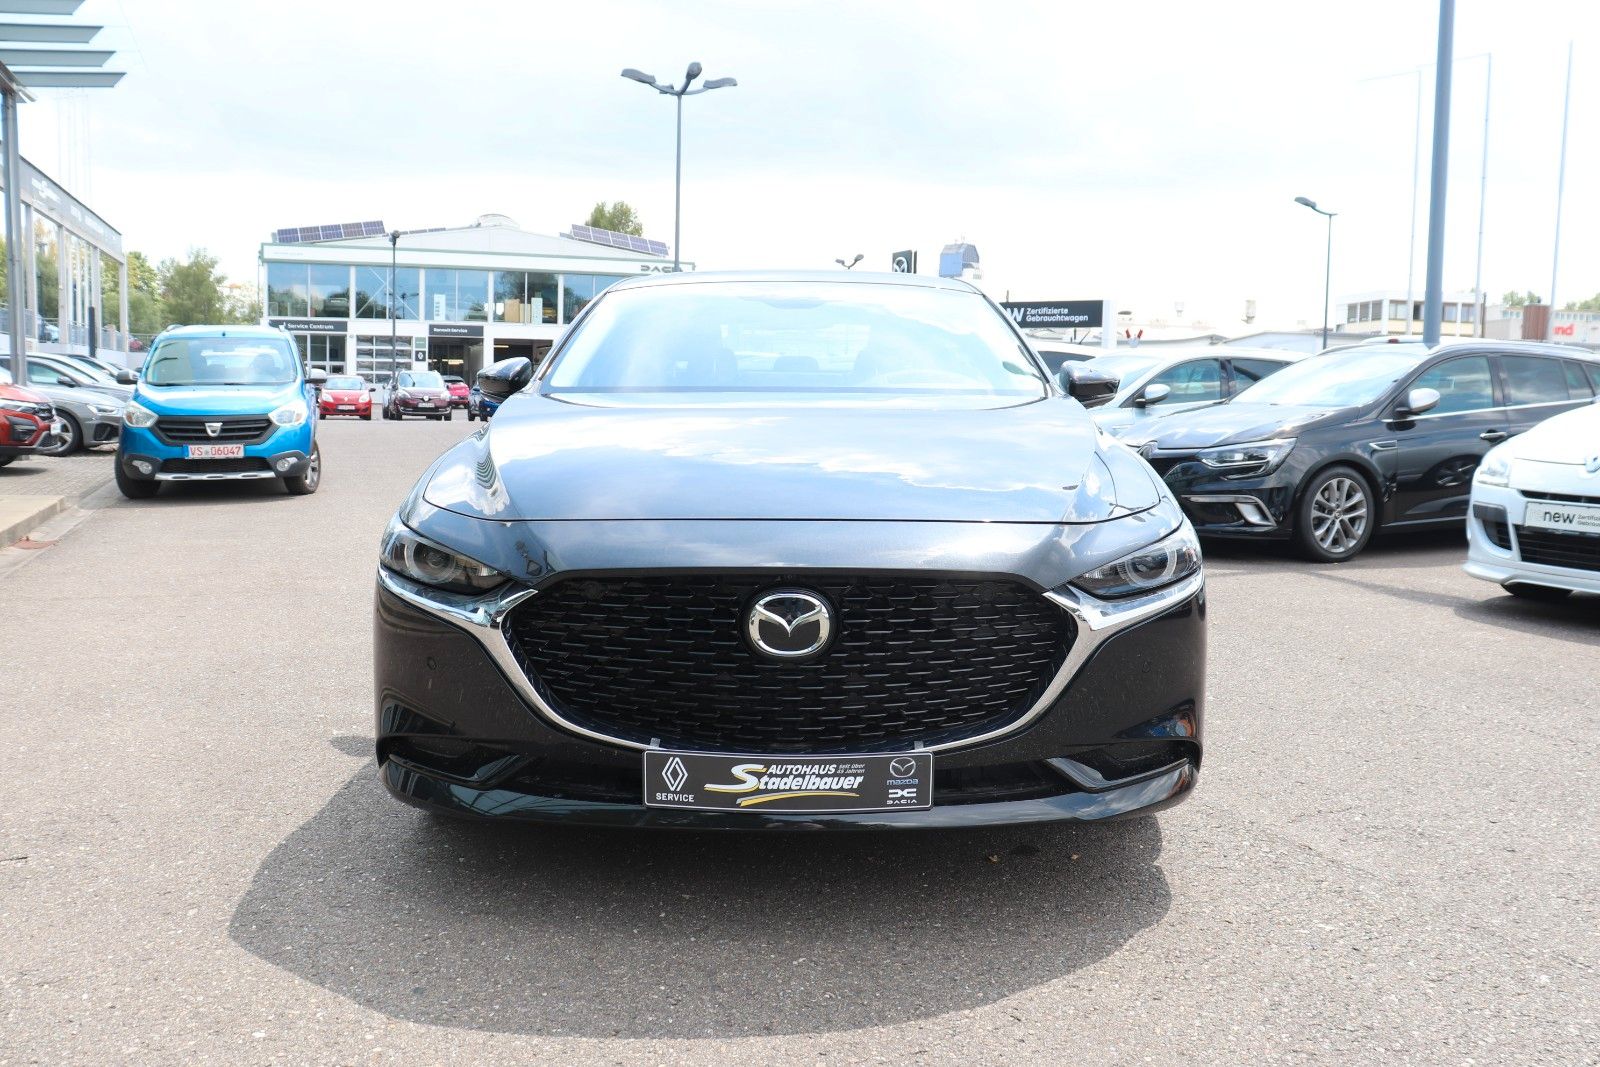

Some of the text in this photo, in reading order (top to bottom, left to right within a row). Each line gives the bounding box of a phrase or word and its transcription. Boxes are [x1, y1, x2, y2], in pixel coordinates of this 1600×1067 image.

[1026, 307, 1069, 315] Zertifizierte
[1026, 314, 1088, 323] Gebrauchtwagen
[287, 322, 309, 330] Service
[190, 445, 241, 456] VS 06047
[1543, 511, 1576, 524] new
[766, 764, 837, 775] AUTOHAUS
[703, 763, 865, 793] Stadelbauer
[886, 778, 919, 786] mazda
[655, 792, 695, 803] SERVICE
